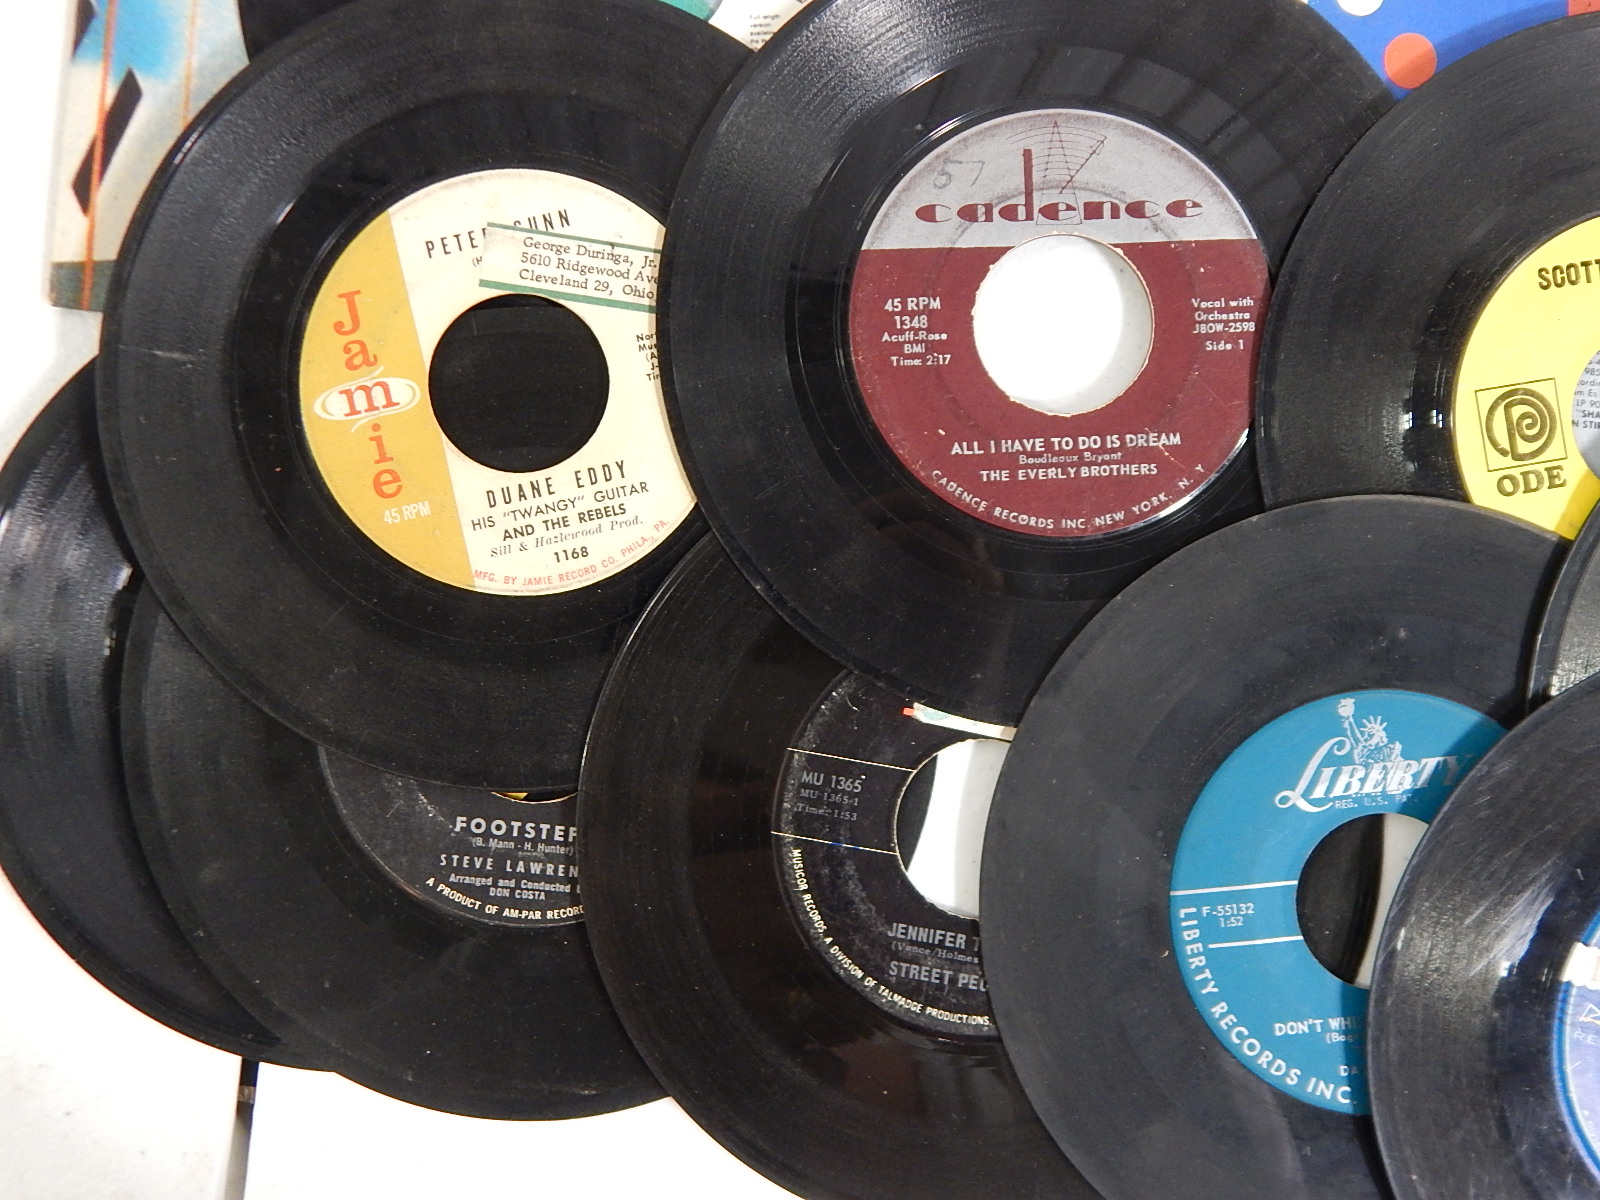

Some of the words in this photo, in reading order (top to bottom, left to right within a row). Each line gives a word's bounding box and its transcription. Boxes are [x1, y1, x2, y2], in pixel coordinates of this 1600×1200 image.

[915, 148, 1203, 223] cadence
[523, 236, 570, 255] George
[641, 255, 657, 269] Jr.
[520, 252, 551, 267] 5610
[556, 258, 630, 280] Ridgewood
[519, 269, 588, 290] Cleveland
[594, 280, 613, 296] 29,
[622, 285, 655, 300] Ohio
[884, 297, 902, 312] 45
[907, 297, 941, 311] RPM
[1191, 298, 1225, 308] Vocal
[1229, 296, 1254, 307] with
[894, 315, 928, 329] 1348
[1195, 310, 1250, 321] Orchestra
[881, 332, 948, 342] Acuff-Rose
[904, 343, 925, 354] BMI
[1206, 340, 1232, 351] Side
[1238, 339, 1244, 350] 1
[891, 356, 922, 367] Time:
[926, 354, 951, 367] 2:17
[333, 289, 403, 499] Jamie
[951, 441, 985, 455] ALL
[990, 440, 996, 453] I
[1001, 438, 1045, 453] HAVE
[1050, 436, 1074, 450] TO
[1078, 435, 1102, 449] DO
[1106, 434, 1121, 448] IS
[1125, 432, 1182, 448] DREAM
[1019, 452, 1078, 465] Boudleaux
[1083, 451, 1122, 465] Bryant
[486, 476, 556, 508] DUANE
[574, 460, 627, 489] EDDY
[980, 469, 1010, 482] THE
[1018, 467, 1077, 480] EVERLY
[1080, 463, 1158, 477] BROTHERS
[1496, 464, 1568, 497] ODE
[471, 516, 496, 531] HIS
[594, 481, 649, 502] GUITAR
[932, 468, 988, 513] CADENCE
[993, 506, 1054, 529] RECORDS
[1095, 510, 1125, 527] NEW
[384, 507, 401, 525] 45
[403, 501, 431, 522] RPM
[502, 524, 535, 541] AND
[542, 516, 570, 531] THE
[578, 503, 627, 523] REBELS
[490, 543, 512, 558] Sill
[519, 542, 529, 552] &
[535, 524, 602, 548] Hazlewood
[610, 516, 644, 531] Prod.
[473, 569, 498, 582] MFG.
[503, 576, 517, 585] BY
[522, 576, 553, 586] JAMIE
[558, 565, 598, 583] RECORD
[602, 553, 619, 567] CO.
[653, 517, 670, 532] PA.
[553, 546, 589, 563] 1168
[801, 770, 824, 785] MU
[831, 775, 863, 793] 1365
[1274, 736, 1475, 813] LIBERTY
[1334, 799, 1358, 809] REG.
[1364, 797, 1388, 807] U.S.
[833, 809, 858, 821] 1:53
[489, 838, 515, 849] Mann
[524, 841, 534, 851] H.
[537, 843, 574, 857] Hunter)
[440, 854, 494, 870] STEVE
[506, 860, 579, 878] LAWREN
[449, 873, 493, 888] Arranged
[498, 878, 515, 888] and
[520, 879, 571, 893] Conducted
[489, 887, 510, 898] DON
[515, 890, 546, 900] COSTA
[425, 877, 435, 887] A
[436, 883, 482, 910] PRODUCT
[485, 904, 500, 915] OF
[502, 907, 542, 920] AM-PAR
[1202, 902, 1255, 916] F-55132
[792, 849, 808, 890] MUSICOR
[824, 936, 833, 945] A
[830, 945, 864, 979] DIVISION
[864, 976, 877, 988] OF
[878, 985, 923, 1013] TALMADGE
[1218, 916, 1244, 928] 1:52
[887, 922, 967, 950] JENNIFER
[889, 960, 953, 985] STREET
[1178, 906, 1219, 995] LIBERTY
[1211, 1001, 1302, 1086] RECORDS
[1274, 1018, 1324, 1036] DON'T
